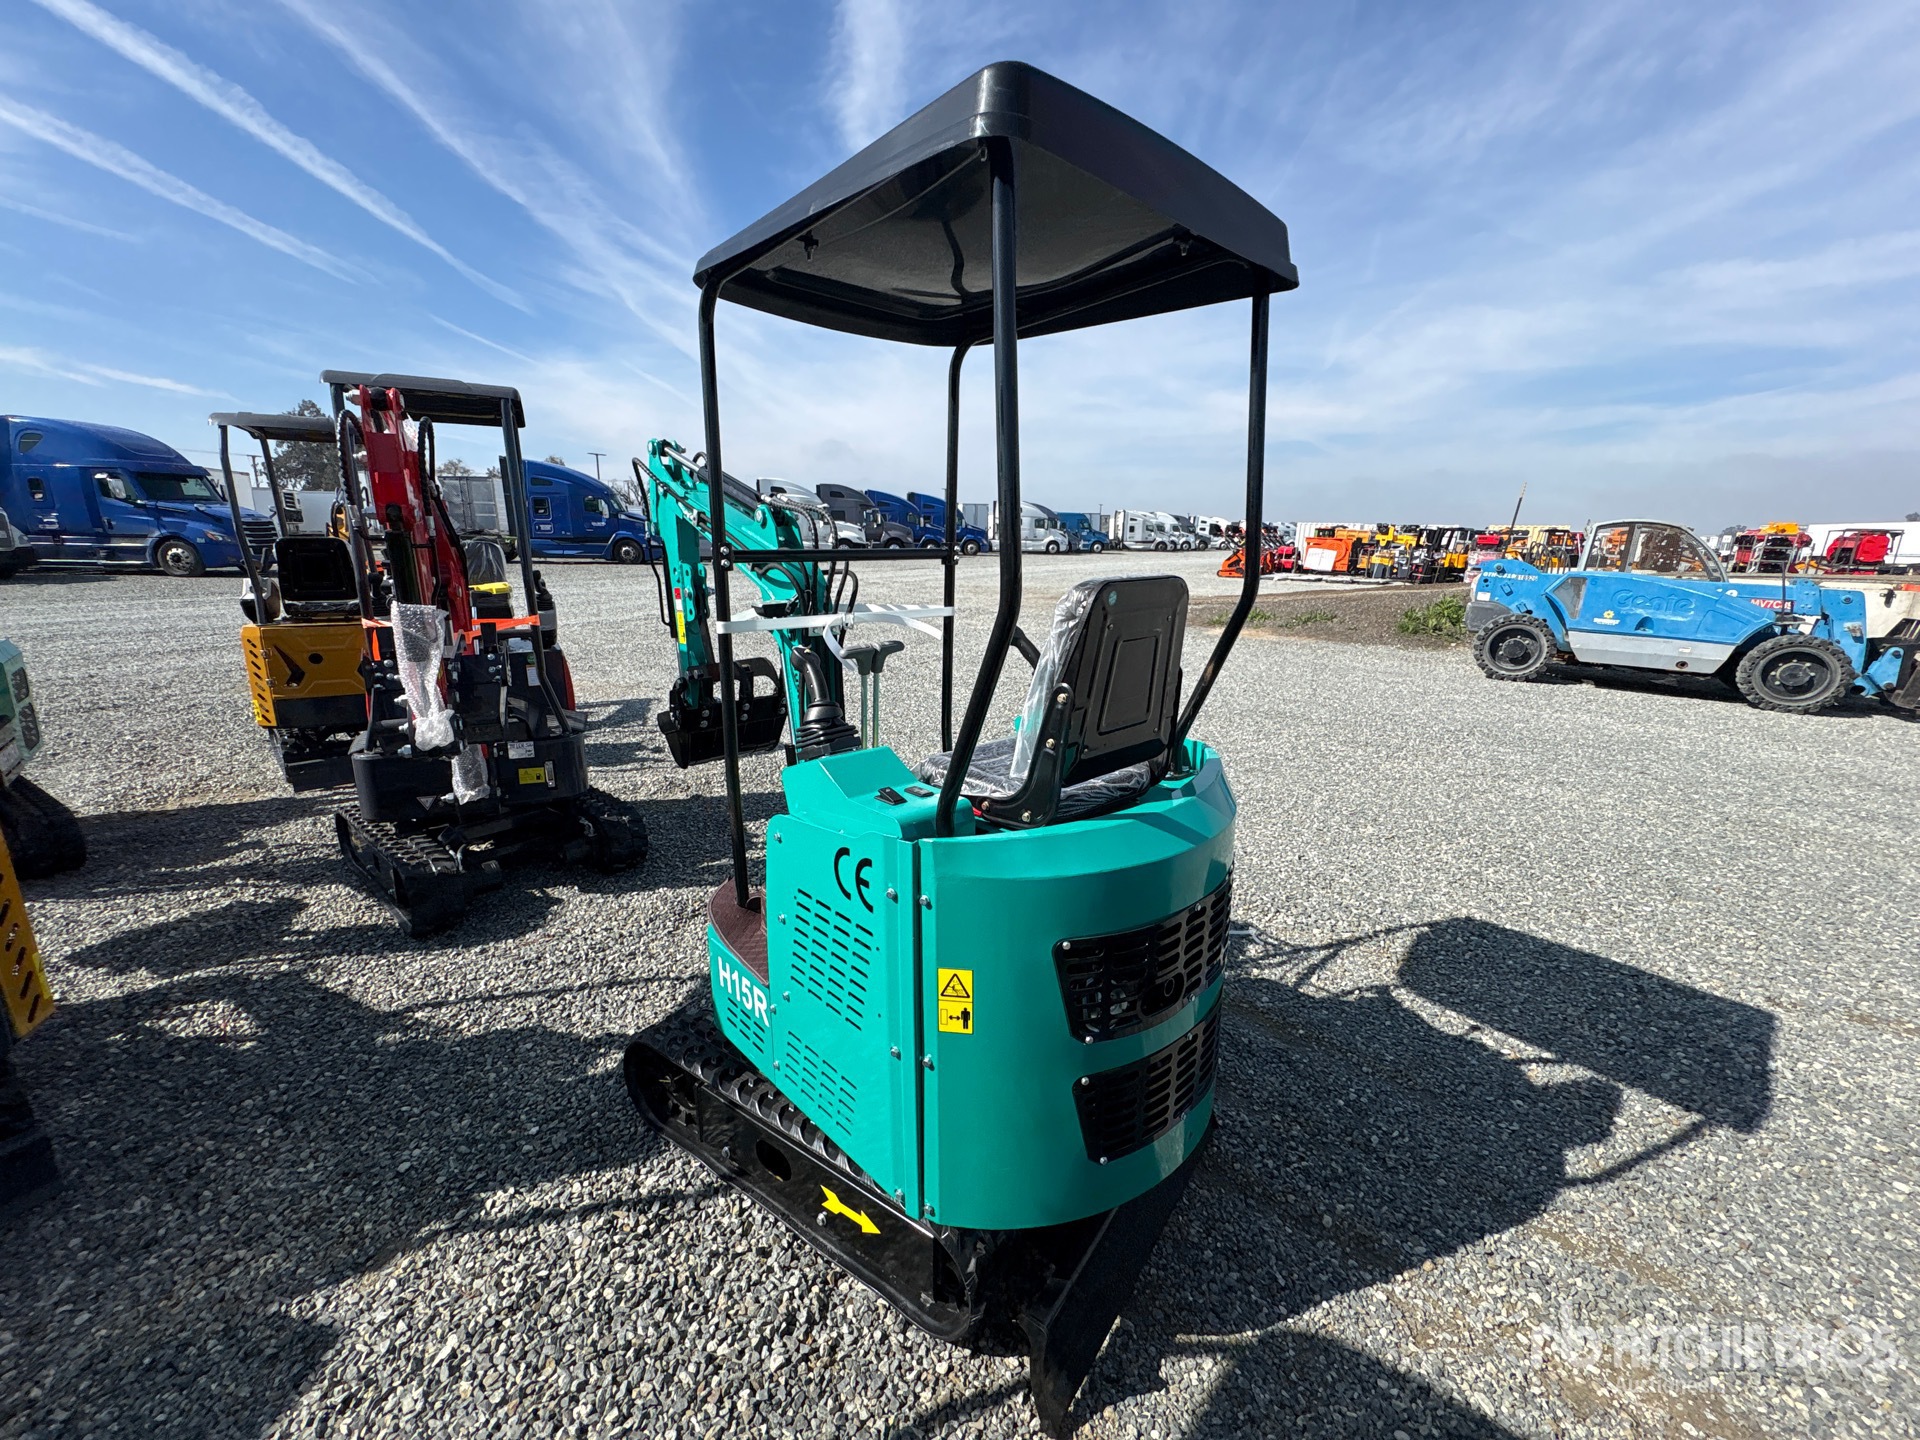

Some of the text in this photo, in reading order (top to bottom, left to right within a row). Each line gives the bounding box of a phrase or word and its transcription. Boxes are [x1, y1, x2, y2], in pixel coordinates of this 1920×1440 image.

[1611, 588, 1696, 613] Genie
[834, 847, 874, 914] CE
[718, 956, 770, 1027] H15R
